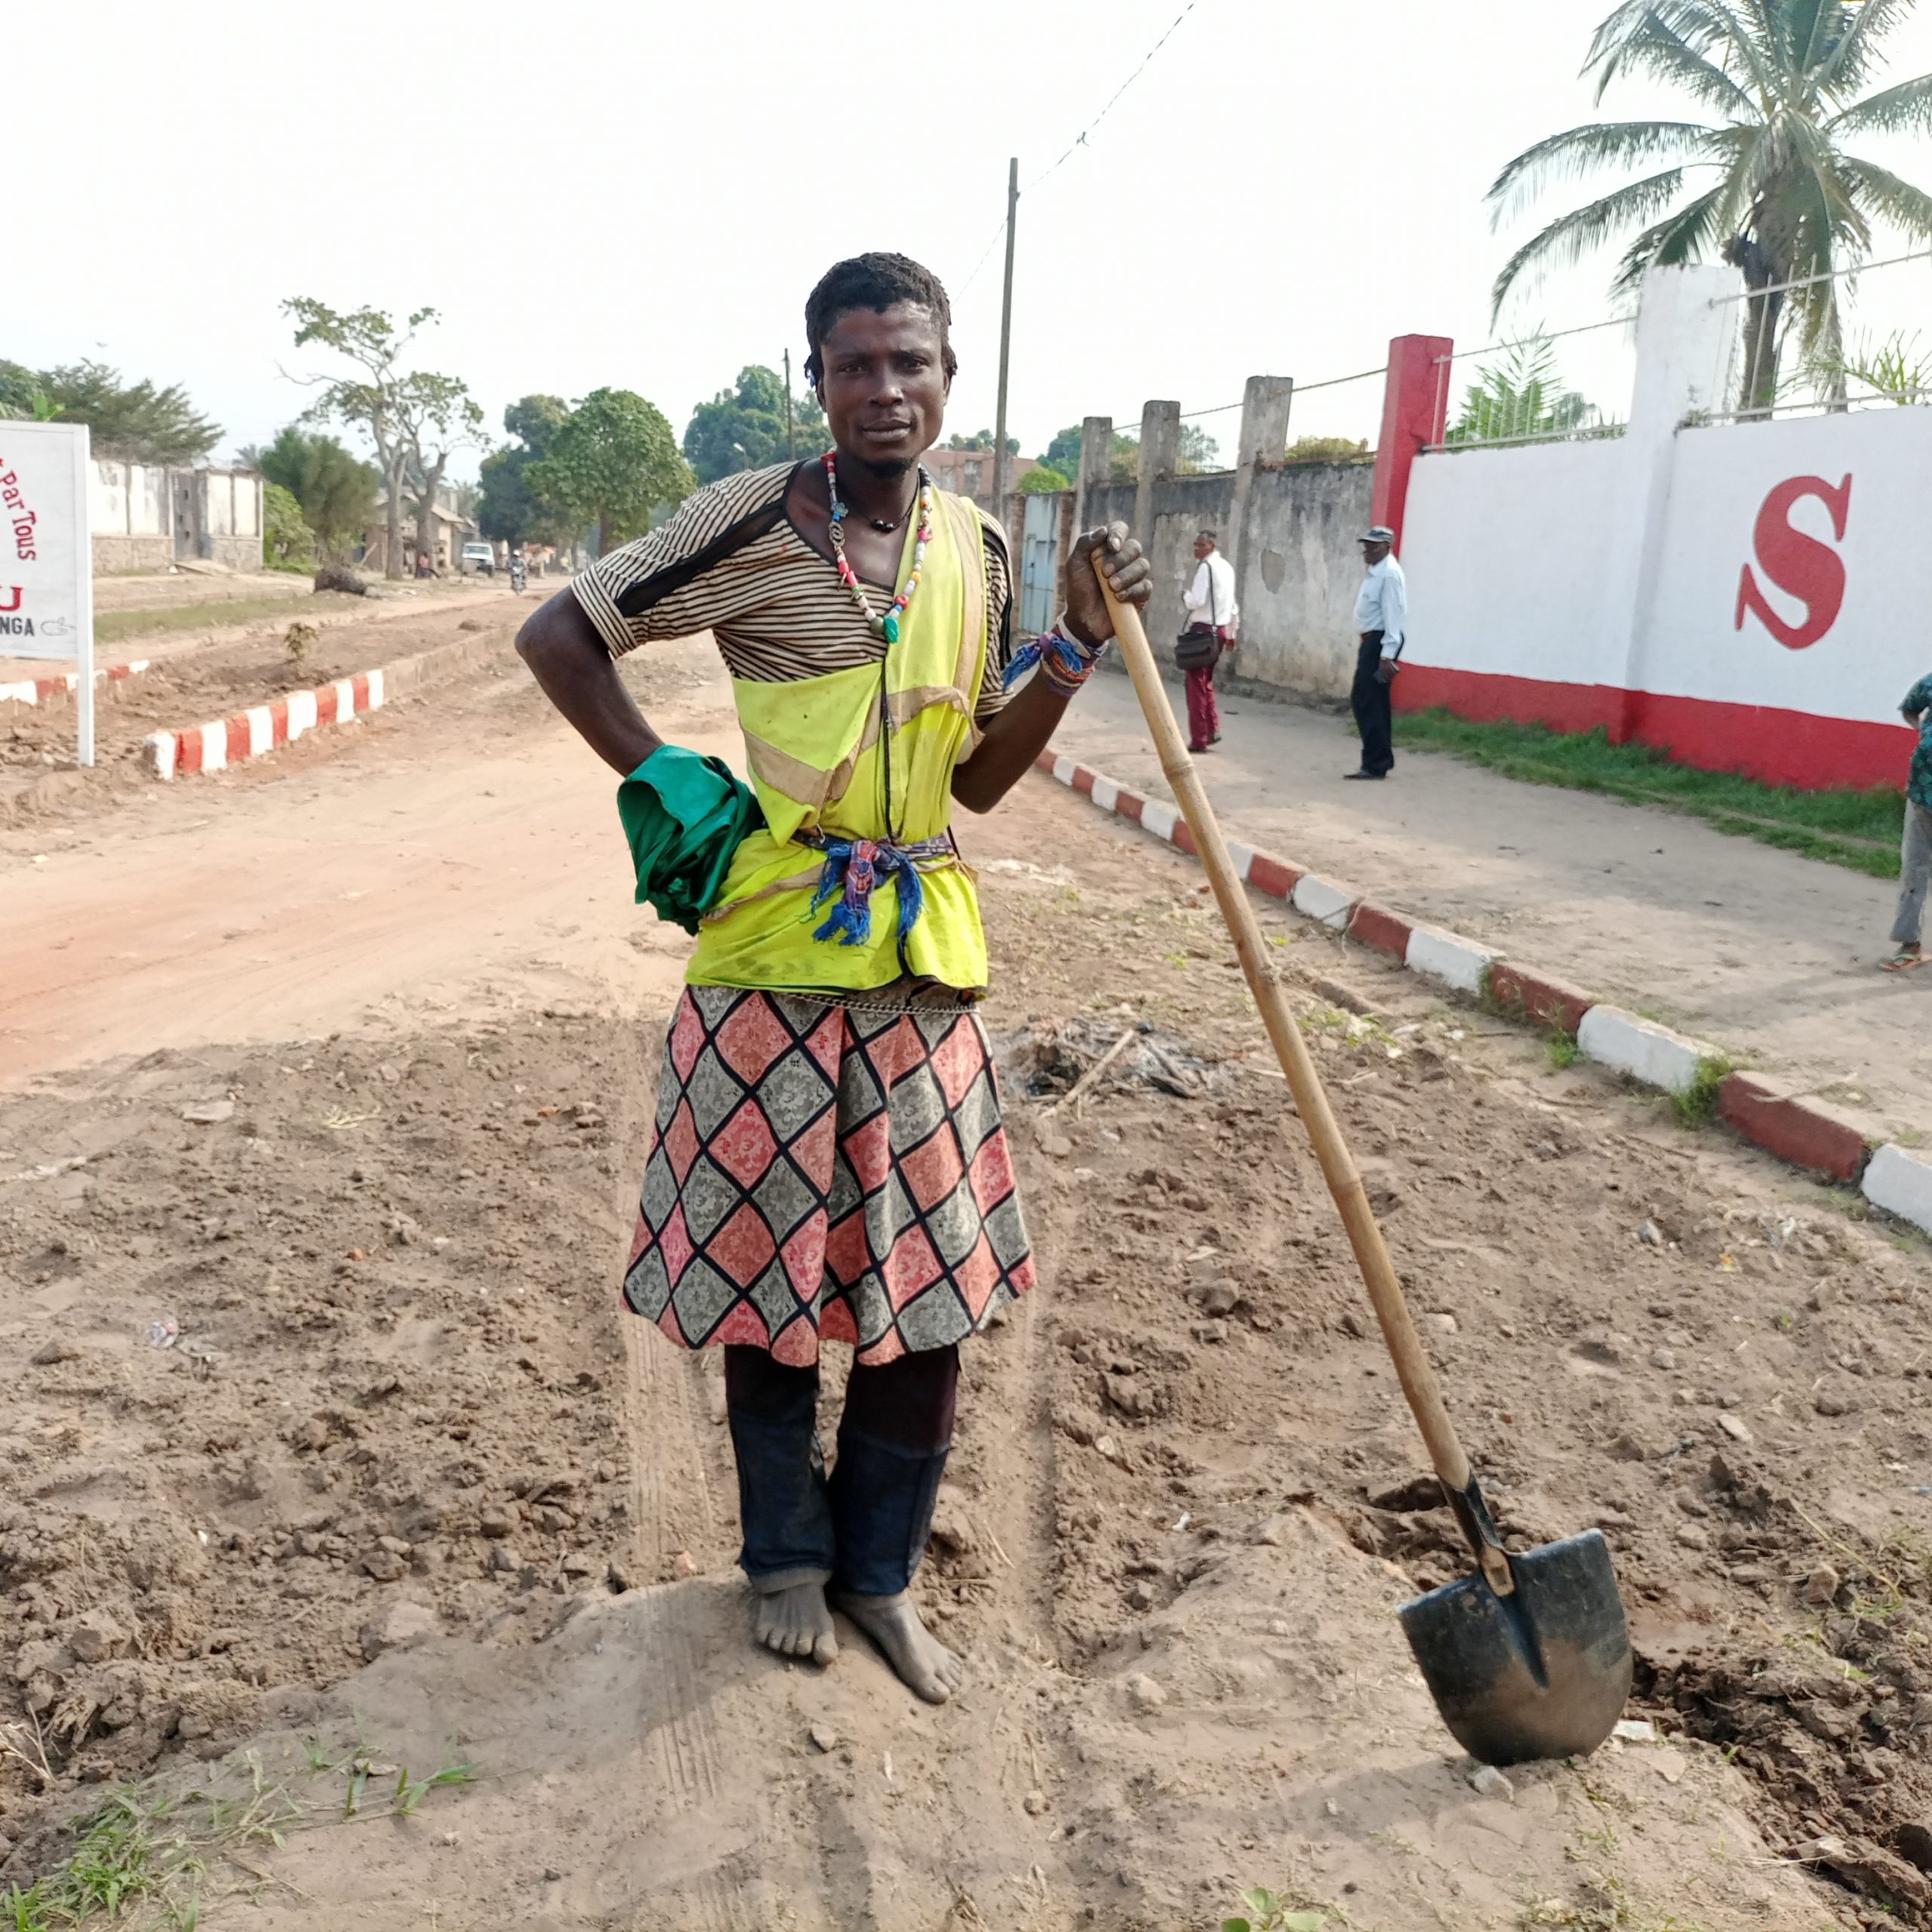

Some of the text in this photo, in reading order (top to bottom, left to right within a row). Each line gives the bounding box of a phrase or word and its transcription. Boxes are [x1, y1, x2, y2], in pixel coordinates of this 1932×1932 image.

[12, 510, 36, 561] Tous
[1735, 472, 1852, 650] S
[0, 616, 35, 637] NGA
